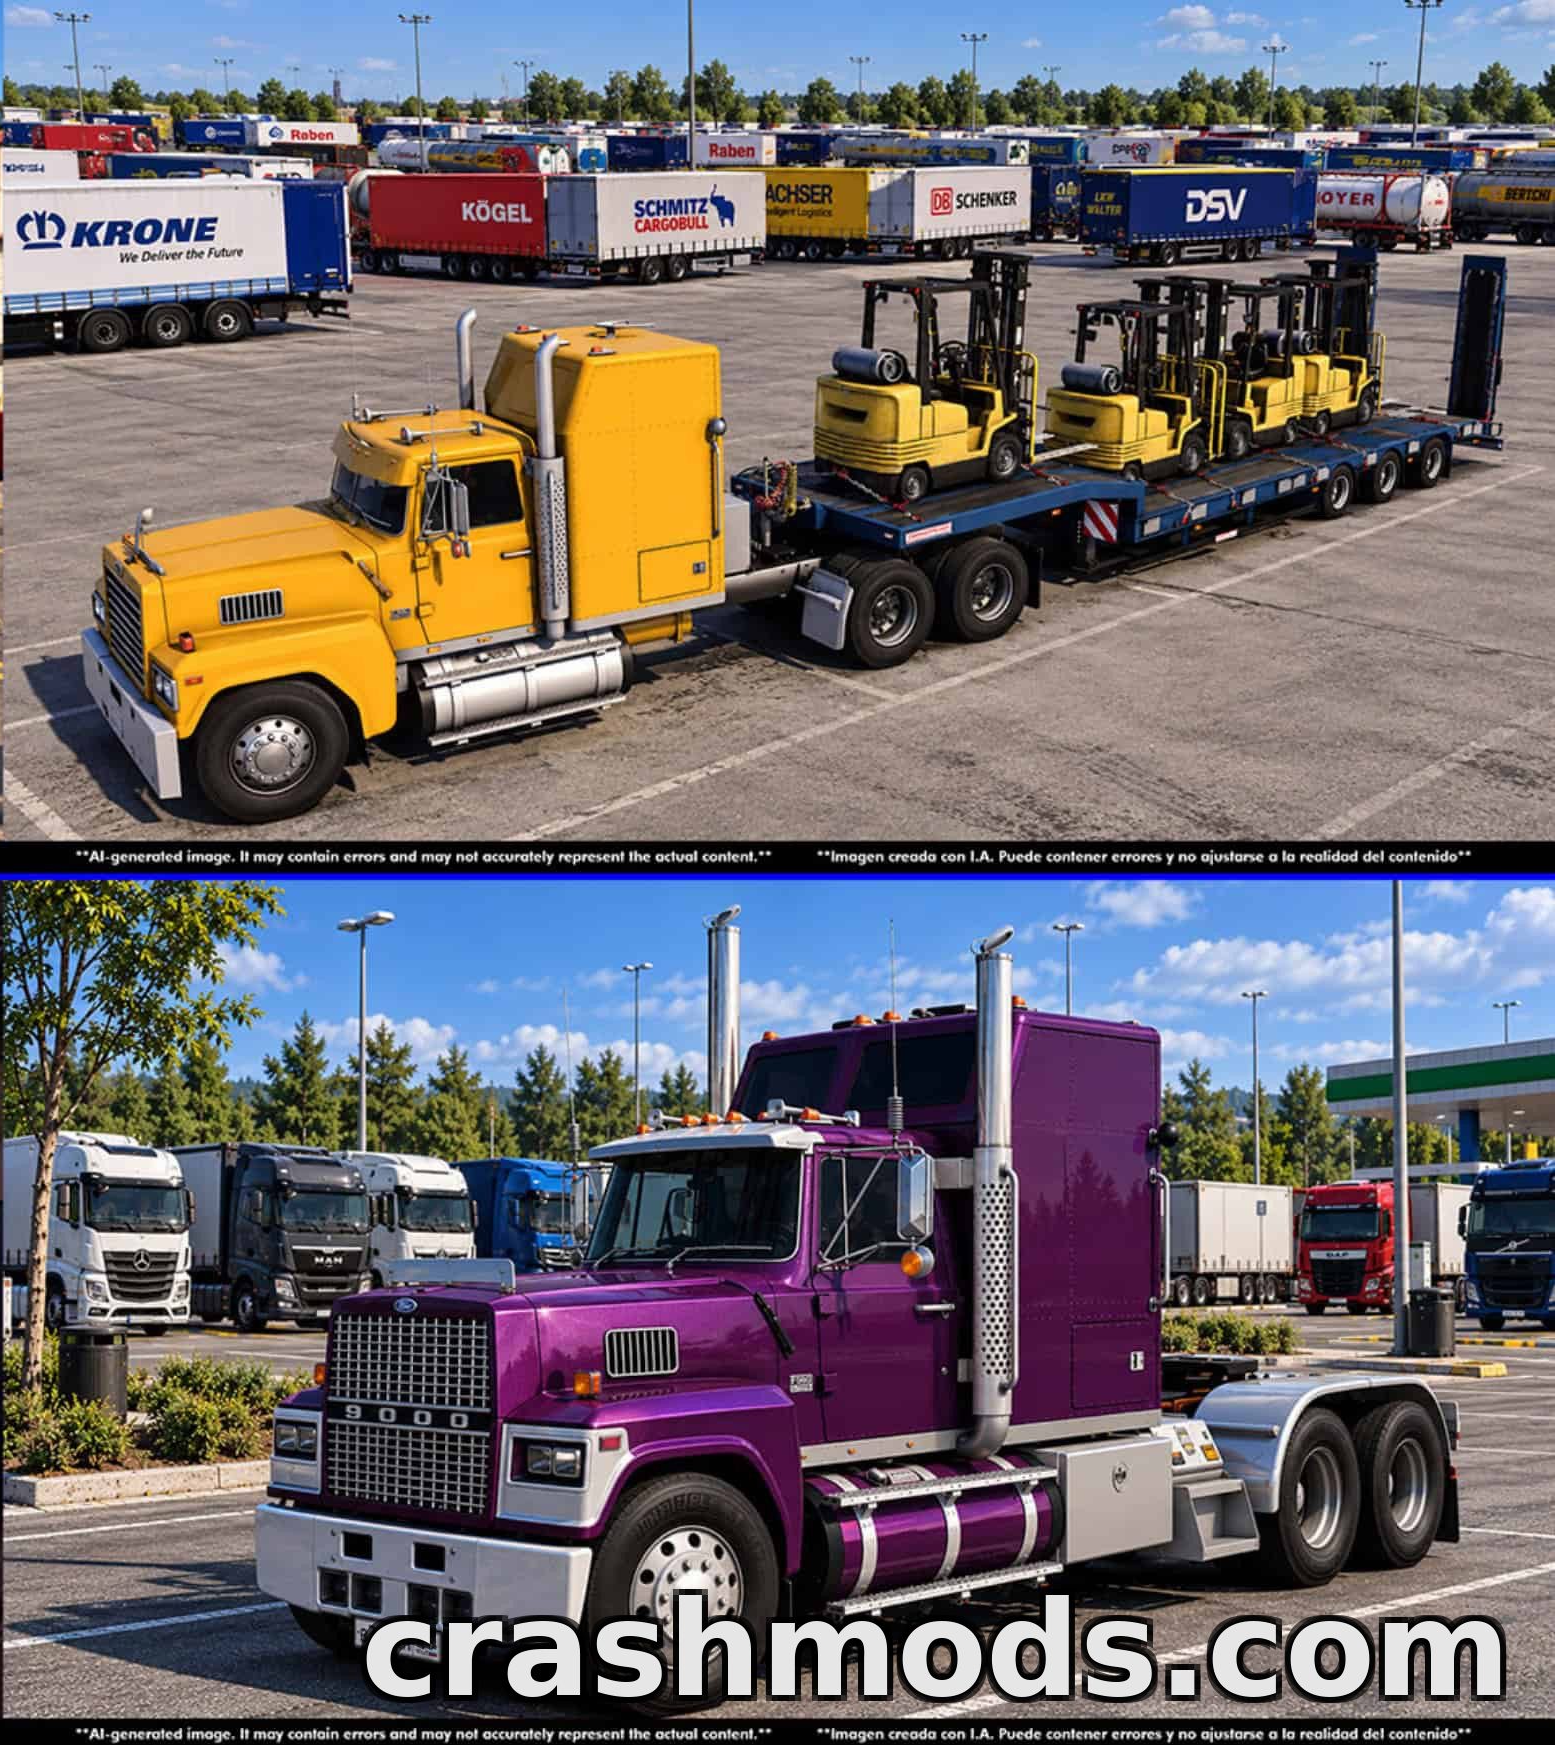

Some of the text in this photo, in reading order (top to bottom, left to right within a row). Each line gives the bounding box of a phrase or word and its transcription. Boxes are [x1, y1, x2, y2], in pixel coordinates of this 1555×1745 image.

[290, 128, 334, 141] Raben
[709, 142, 756, 159] Raben
[766, 184, 833, 204] ACHSER
[932, 189, 1017, 212] DB SCHENKER
[1317, 191, 1374, 206] OYER
[461, 199, 532, 223] KÖGEL
[634, 198, 708, 217] SCHMITZ
[1186, 189, 1246, 222] DSV
[70, 217, 219, 248] KRONE
[634, 215, 709, 233] CARGOBULL
[119, 247, 244, 263] We Deliver the Future
[314, 1256, 343, 1265] MAN
[345, 1404, 469, 1429] 9000
